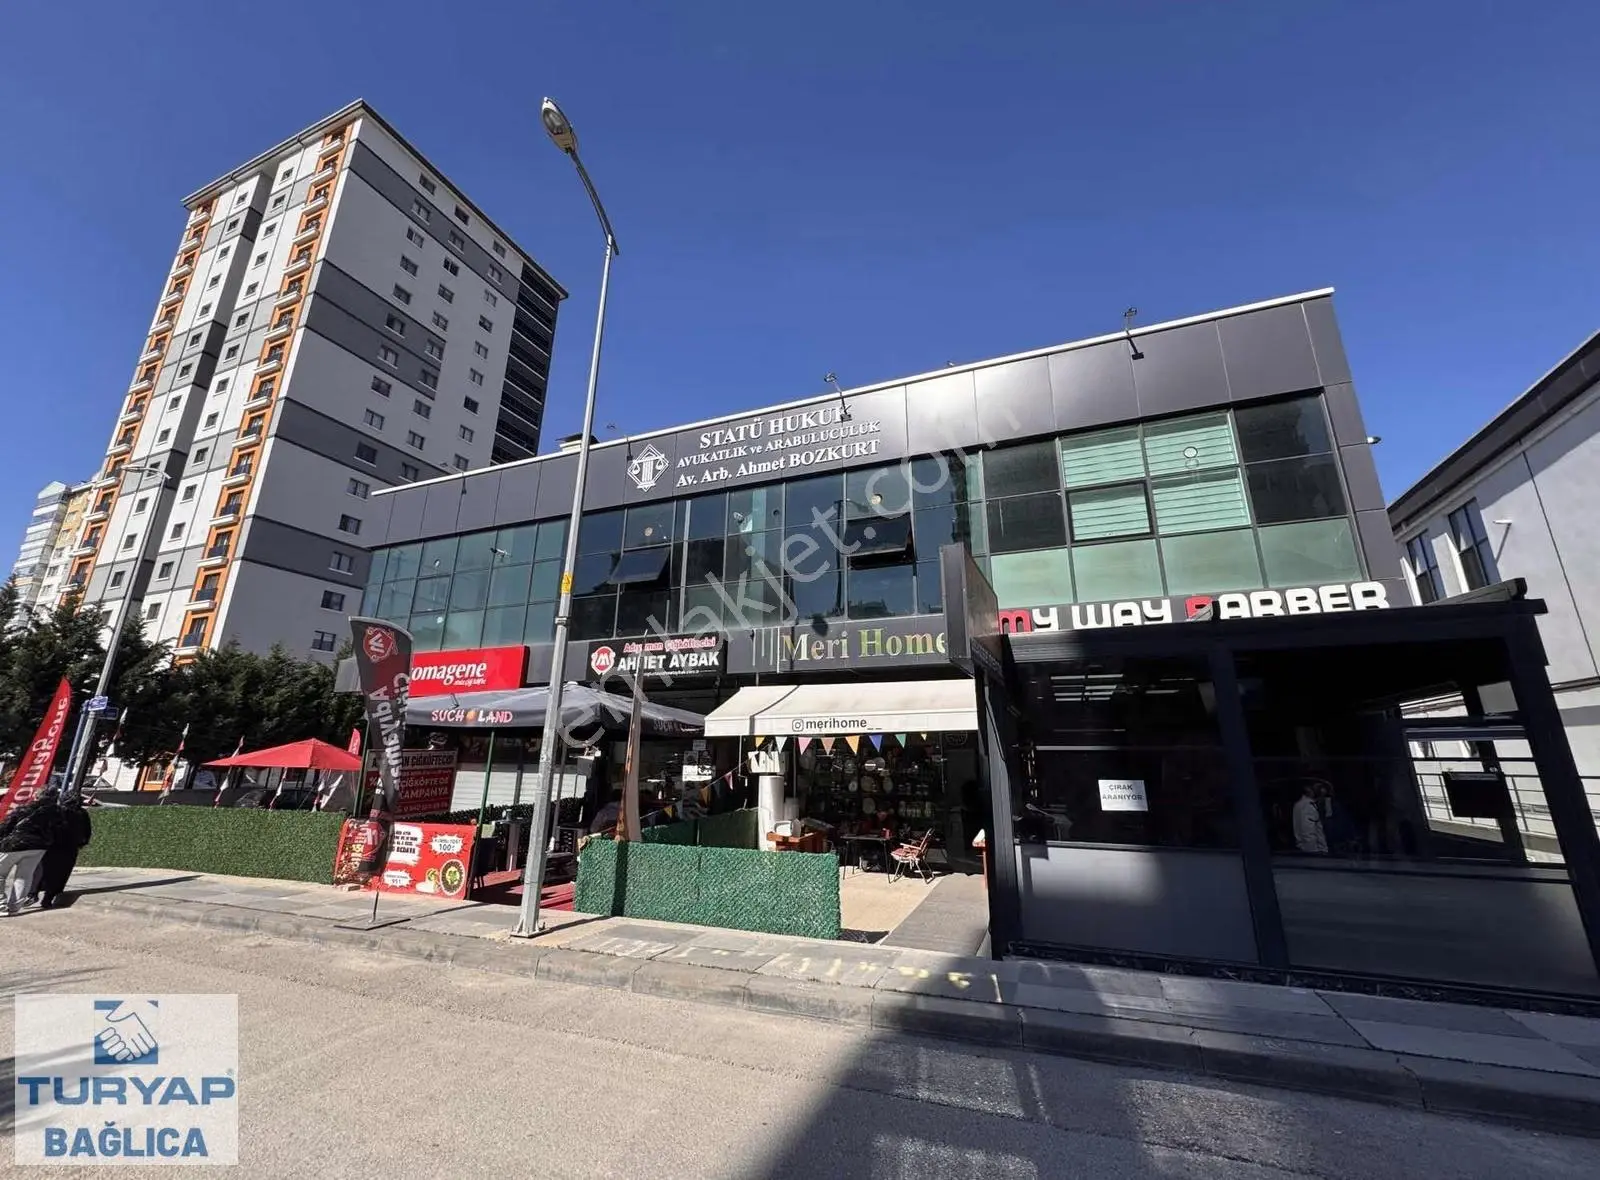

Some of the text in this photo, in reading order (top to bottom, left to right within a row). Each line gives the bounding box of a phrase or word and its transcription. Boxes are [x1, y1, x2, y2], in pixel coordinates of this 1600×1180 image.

[700, 404, 852, 449] STATÜ HUKUK
[676, 421, 880, 468] AVUKATLIK ve ARABULUCULUK
[676, 439, 880, 487] Av. Arb. Ahmet BOZKURT
[1071, 599, 1173, 630] WAY
[624, 642, 664, 655] Adıyman
[669, 651, 720, 668] AYBAK
[780, 631, 849, 662] Meri
[411, 662, 487, 686] omagene
[431, 709, 513, 723] SUCH LAND
